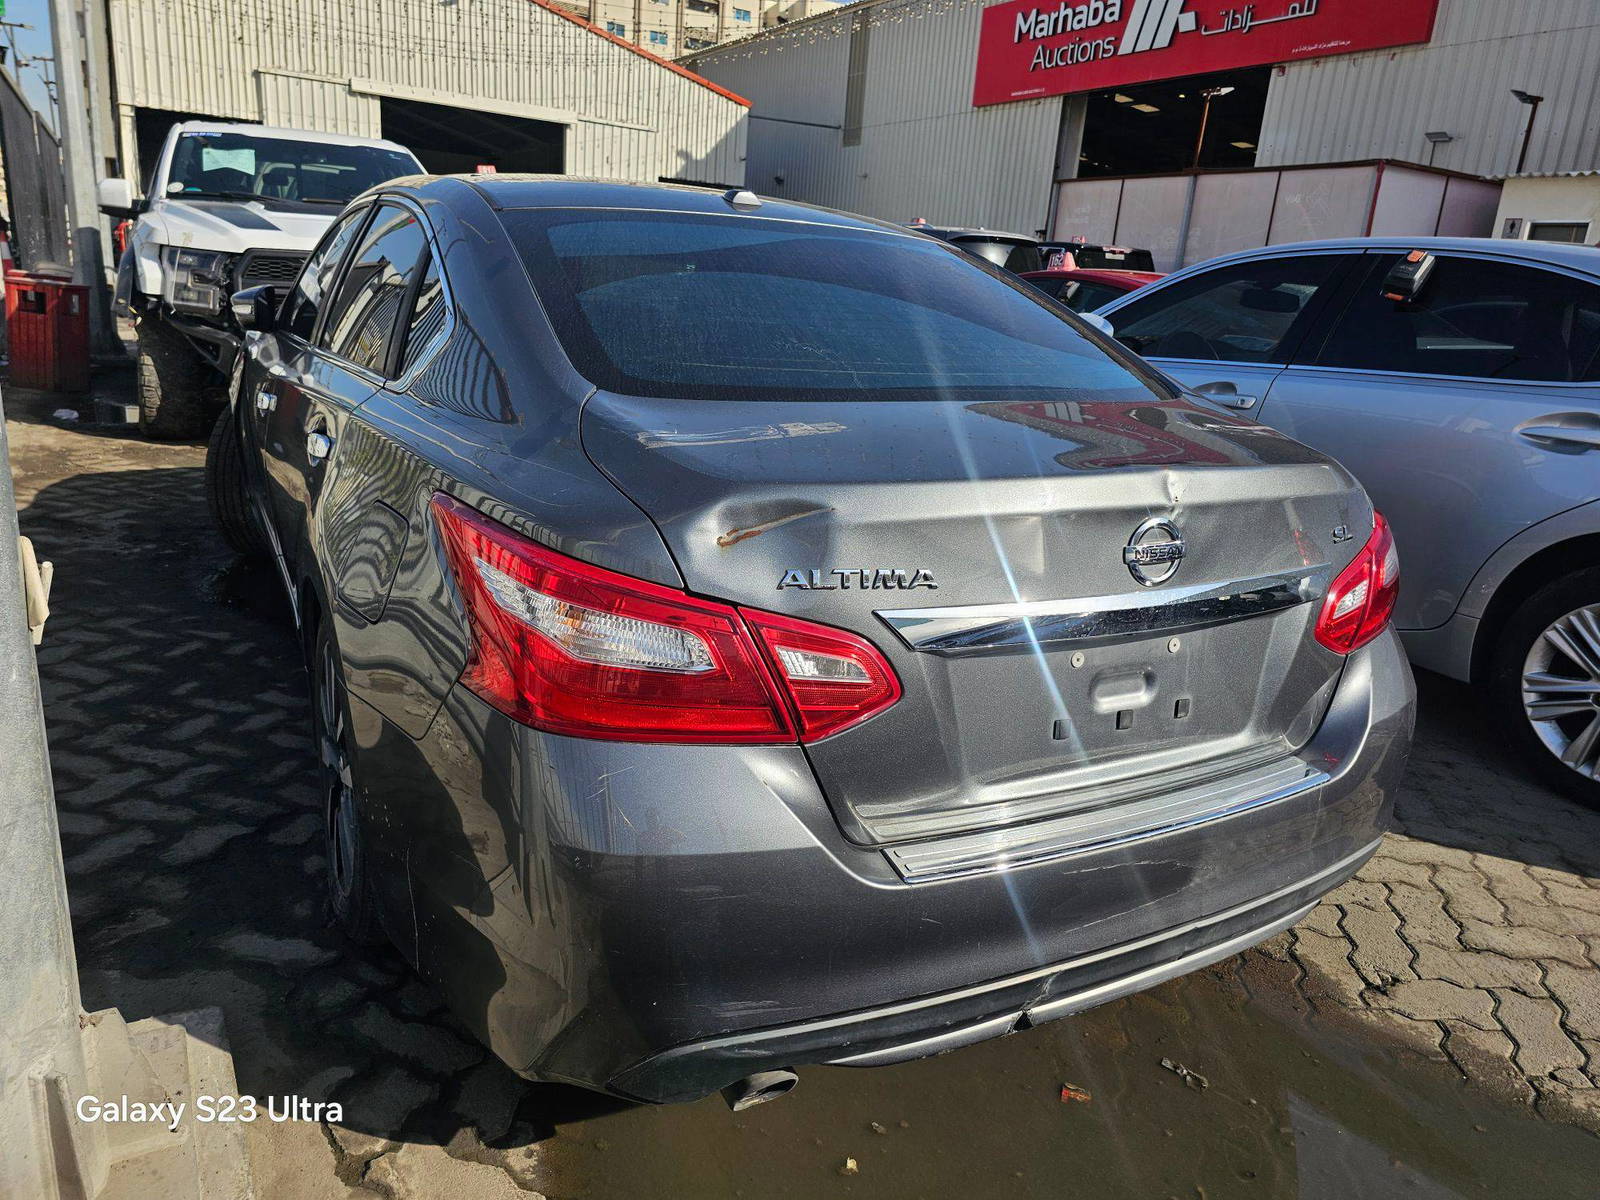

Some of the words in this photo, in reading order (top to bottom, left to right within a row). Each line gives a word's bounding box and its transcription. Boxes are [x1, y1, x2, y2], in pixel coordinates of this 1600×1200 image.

[1014, 0, 1121, 43] Marhaba
[1029, 36, 1116, 72] Auctions
[1134, 544, 1184, 560] NISSAN
[776, 569, 939, 590] ALTIMA
